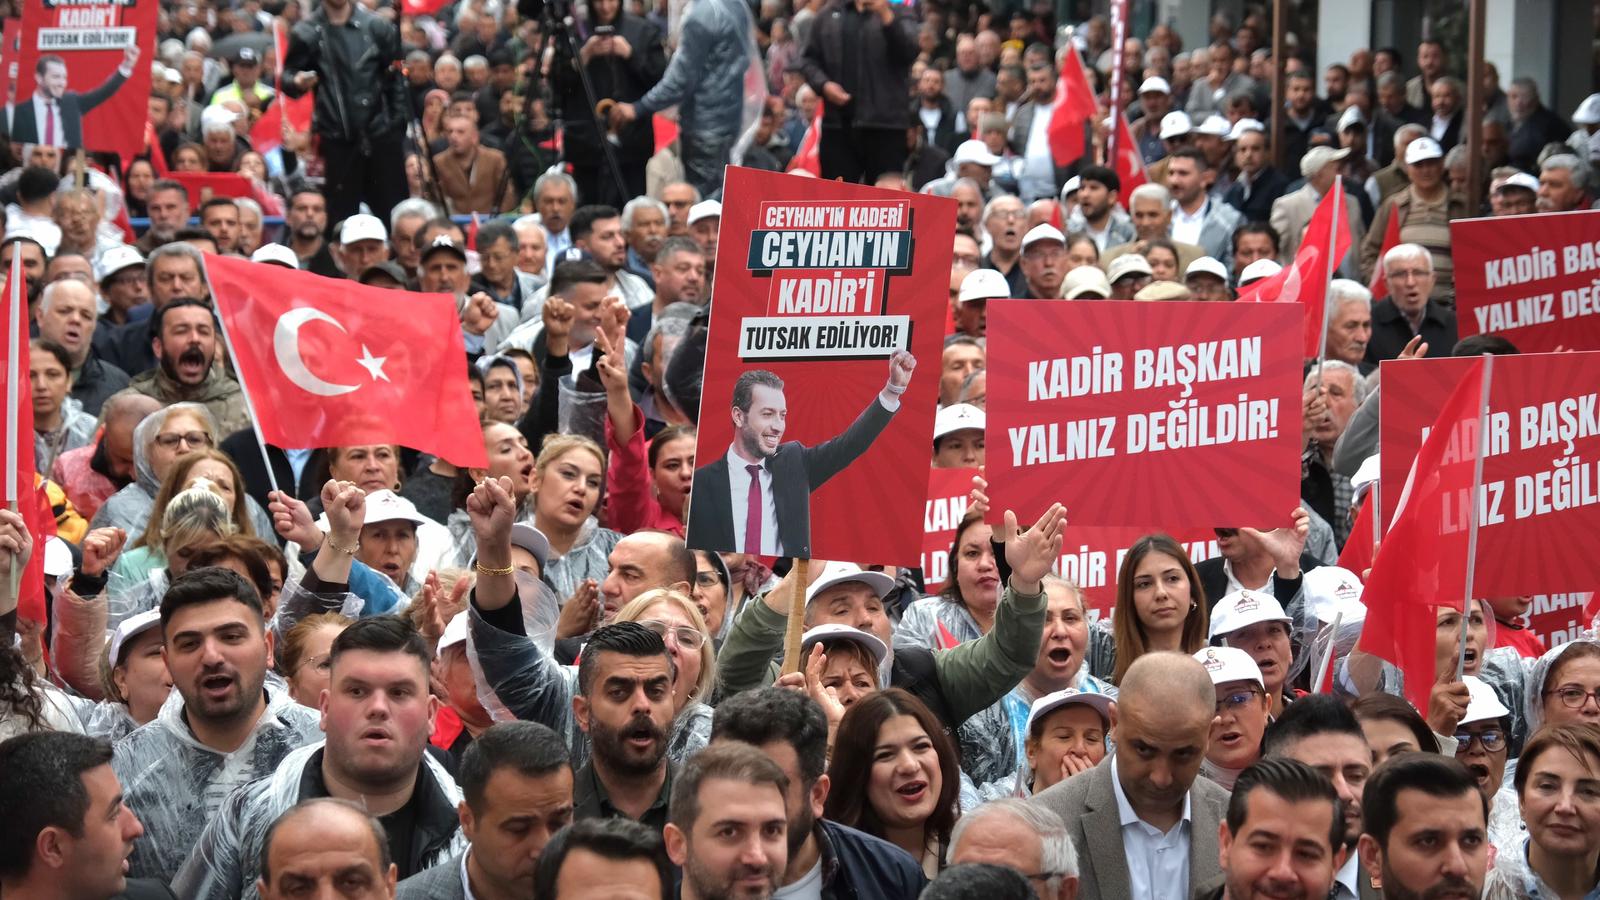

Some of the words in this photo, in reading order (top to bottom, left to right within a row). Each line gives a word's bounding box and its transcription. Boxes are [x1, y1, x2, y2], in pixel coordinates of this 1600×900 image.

[42, 33, 79, 44] TUTSAK
[848, 203, 904, 228] KADERİ
[1485, 246, 1557, 289] KADİR
[746, 326, 812, 350] TUTSAK
[815, 321, 899, 349] EDİLİYOR!
[1474, 293, 1555, 335] YALNIZ
[1028, 345, 1123, 401] KADİR
[1134, 336, 1262, 397] BAŞKAN
[1008, 416, 1117, 467] YALNIZ
[1126, 392, 1280, 455] DEĞİLDİR!
[1520, 393, 1600, 456] BAŞK
[1515, 455, 1600, 520] DEĞİL
